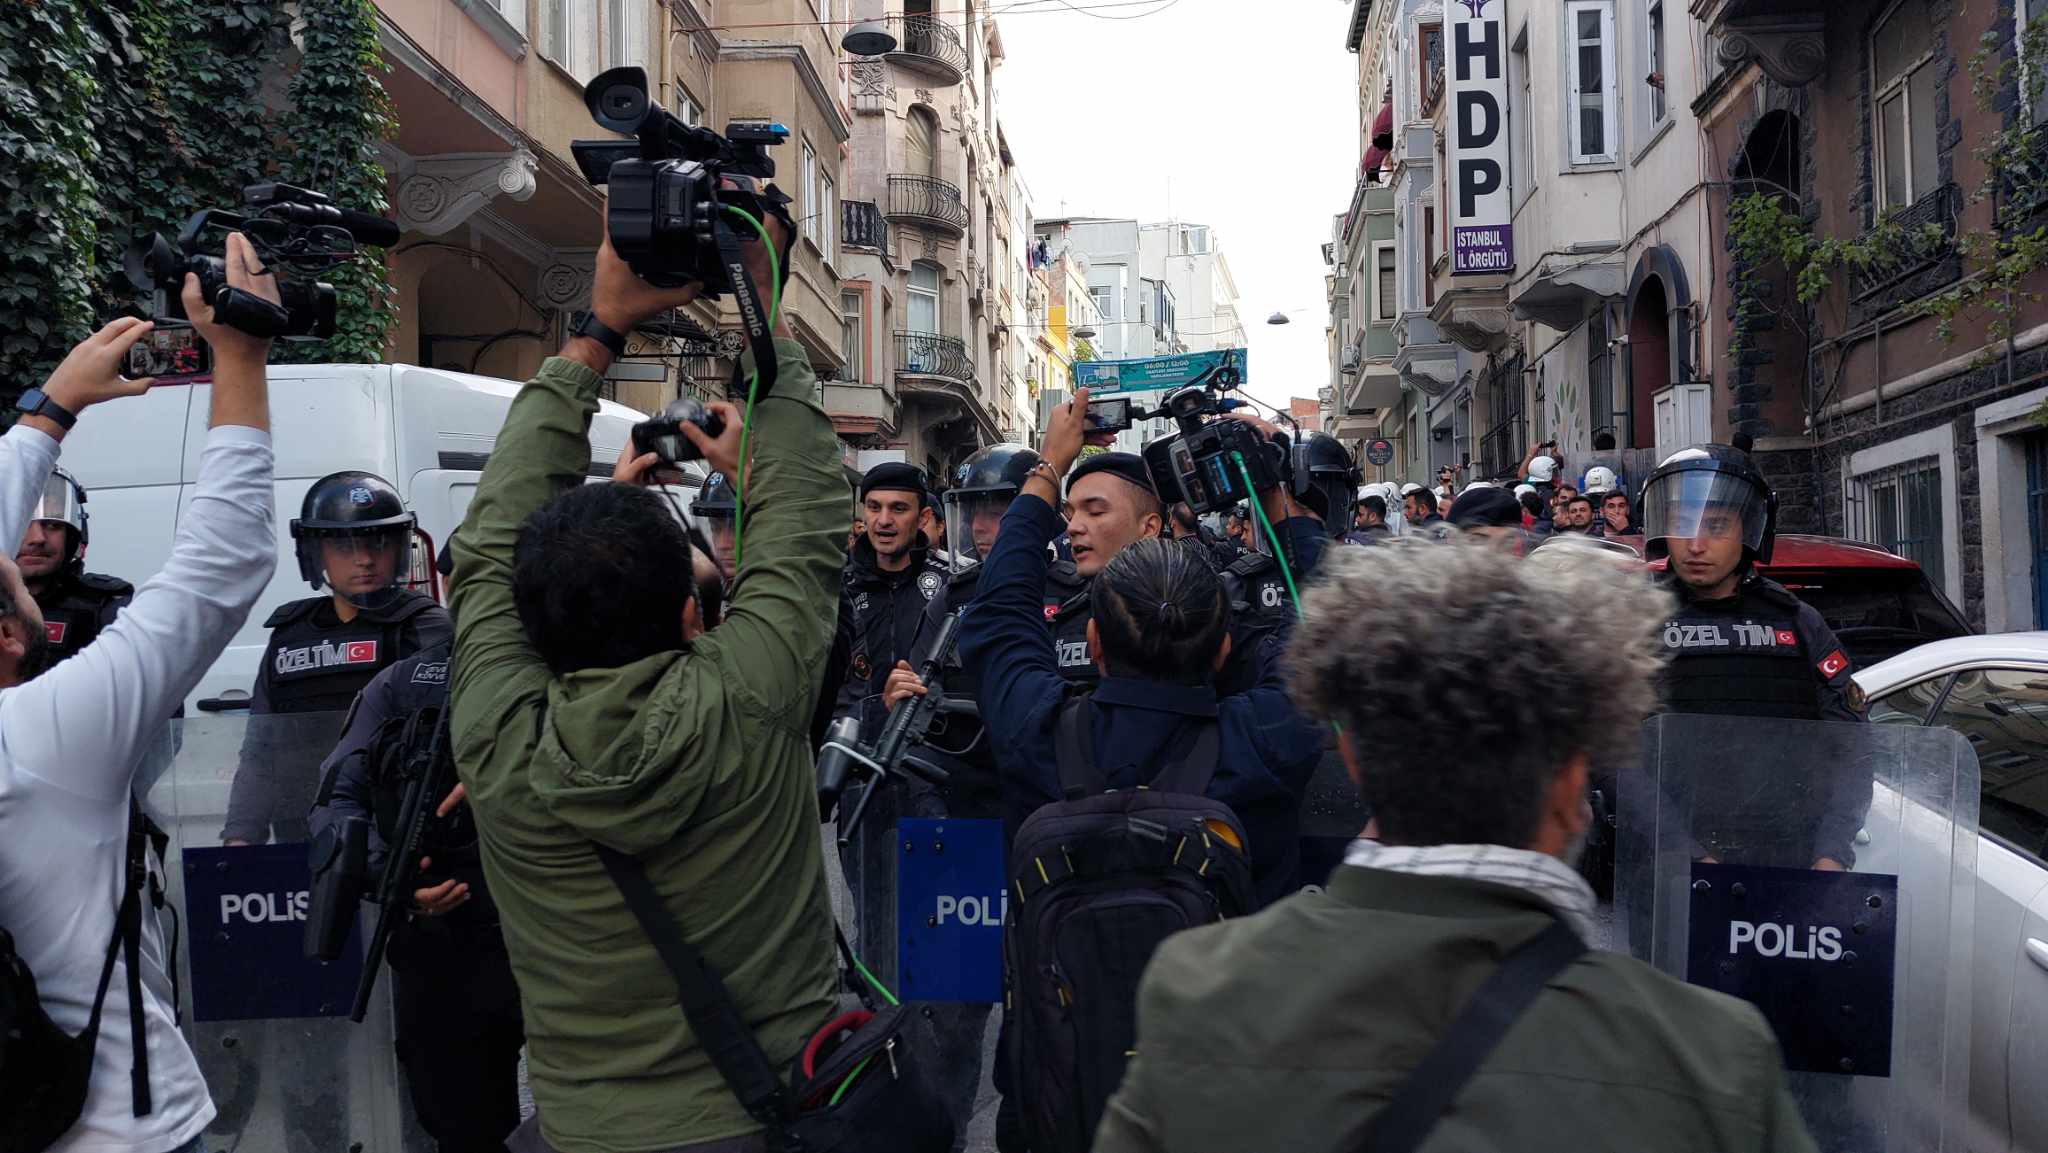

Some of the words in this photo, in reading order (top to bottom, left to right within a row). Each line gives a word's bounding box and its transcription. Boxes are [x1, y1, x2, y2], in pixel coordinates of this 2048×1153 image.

[1455, 20, 1502, 218] HDP
[1457, 227, 1503, 248] İSTANBUL
[1457, 250, 1467, 269] İL
[1468, 248, 1508, 268] ÖRGÜTÜ
[729, 263, 763, 337] Panasonic
[1664, 621, 1729, 648] ÖZEL
[1732, 620, 1777, 646] TİM
[275, 647, 314, 674] ÖZEL
[311, 639, 347, 667] TİM
